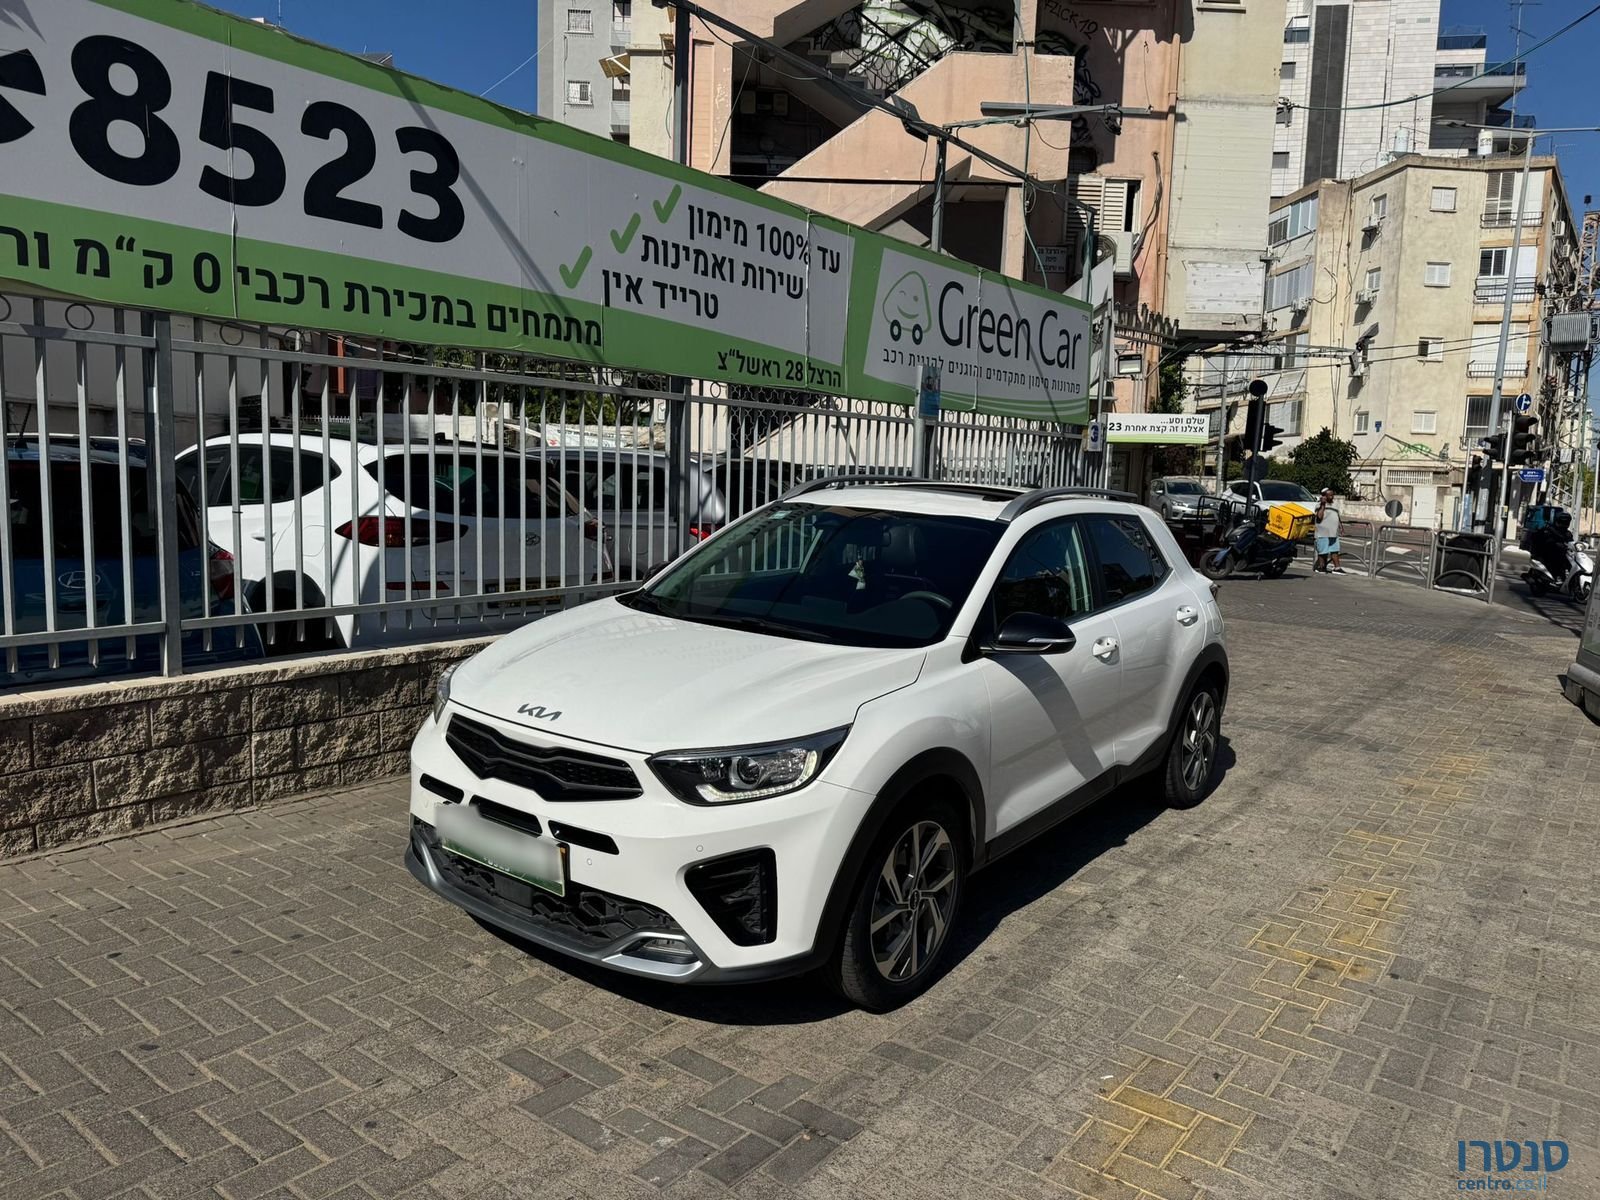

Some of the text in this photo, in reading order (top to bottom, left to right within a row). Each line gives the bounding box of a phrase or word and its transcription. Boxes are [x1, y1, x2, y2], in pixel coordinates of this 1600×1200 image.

[688, 204, 840, 274] עד 100% מימון
[73, 234, 173, 289] ק"מ
[193, 252, 221, 294] 0
[641, 234, 803, 300] שירות ואמינות
[237, 265, 330, 309] רכבי
[344, 281, 476, 328] במכירת
[602, 269, 719, 319] טרייד אין
[487, 303, 602, 346] מתמחים
[938, 280, 1082, 370] Green Car
[717, 348, 841, 388] הרצל 28 ראשל"צ
[883, 348, 904, 365] רכב
[948, 360, 983, 378] והוגנים
[986, 367, 1026, 386] מתקדמים
[1028, 374, 1049, 390] מימון
[1051, 379, 1081, 394] פתרונות
[1108, 422, 1204, 434] אצלנו זה קצת אחרת 23
[1186, 416, 1205, 424] שלם
[517, 703, 563, 722] KIA
